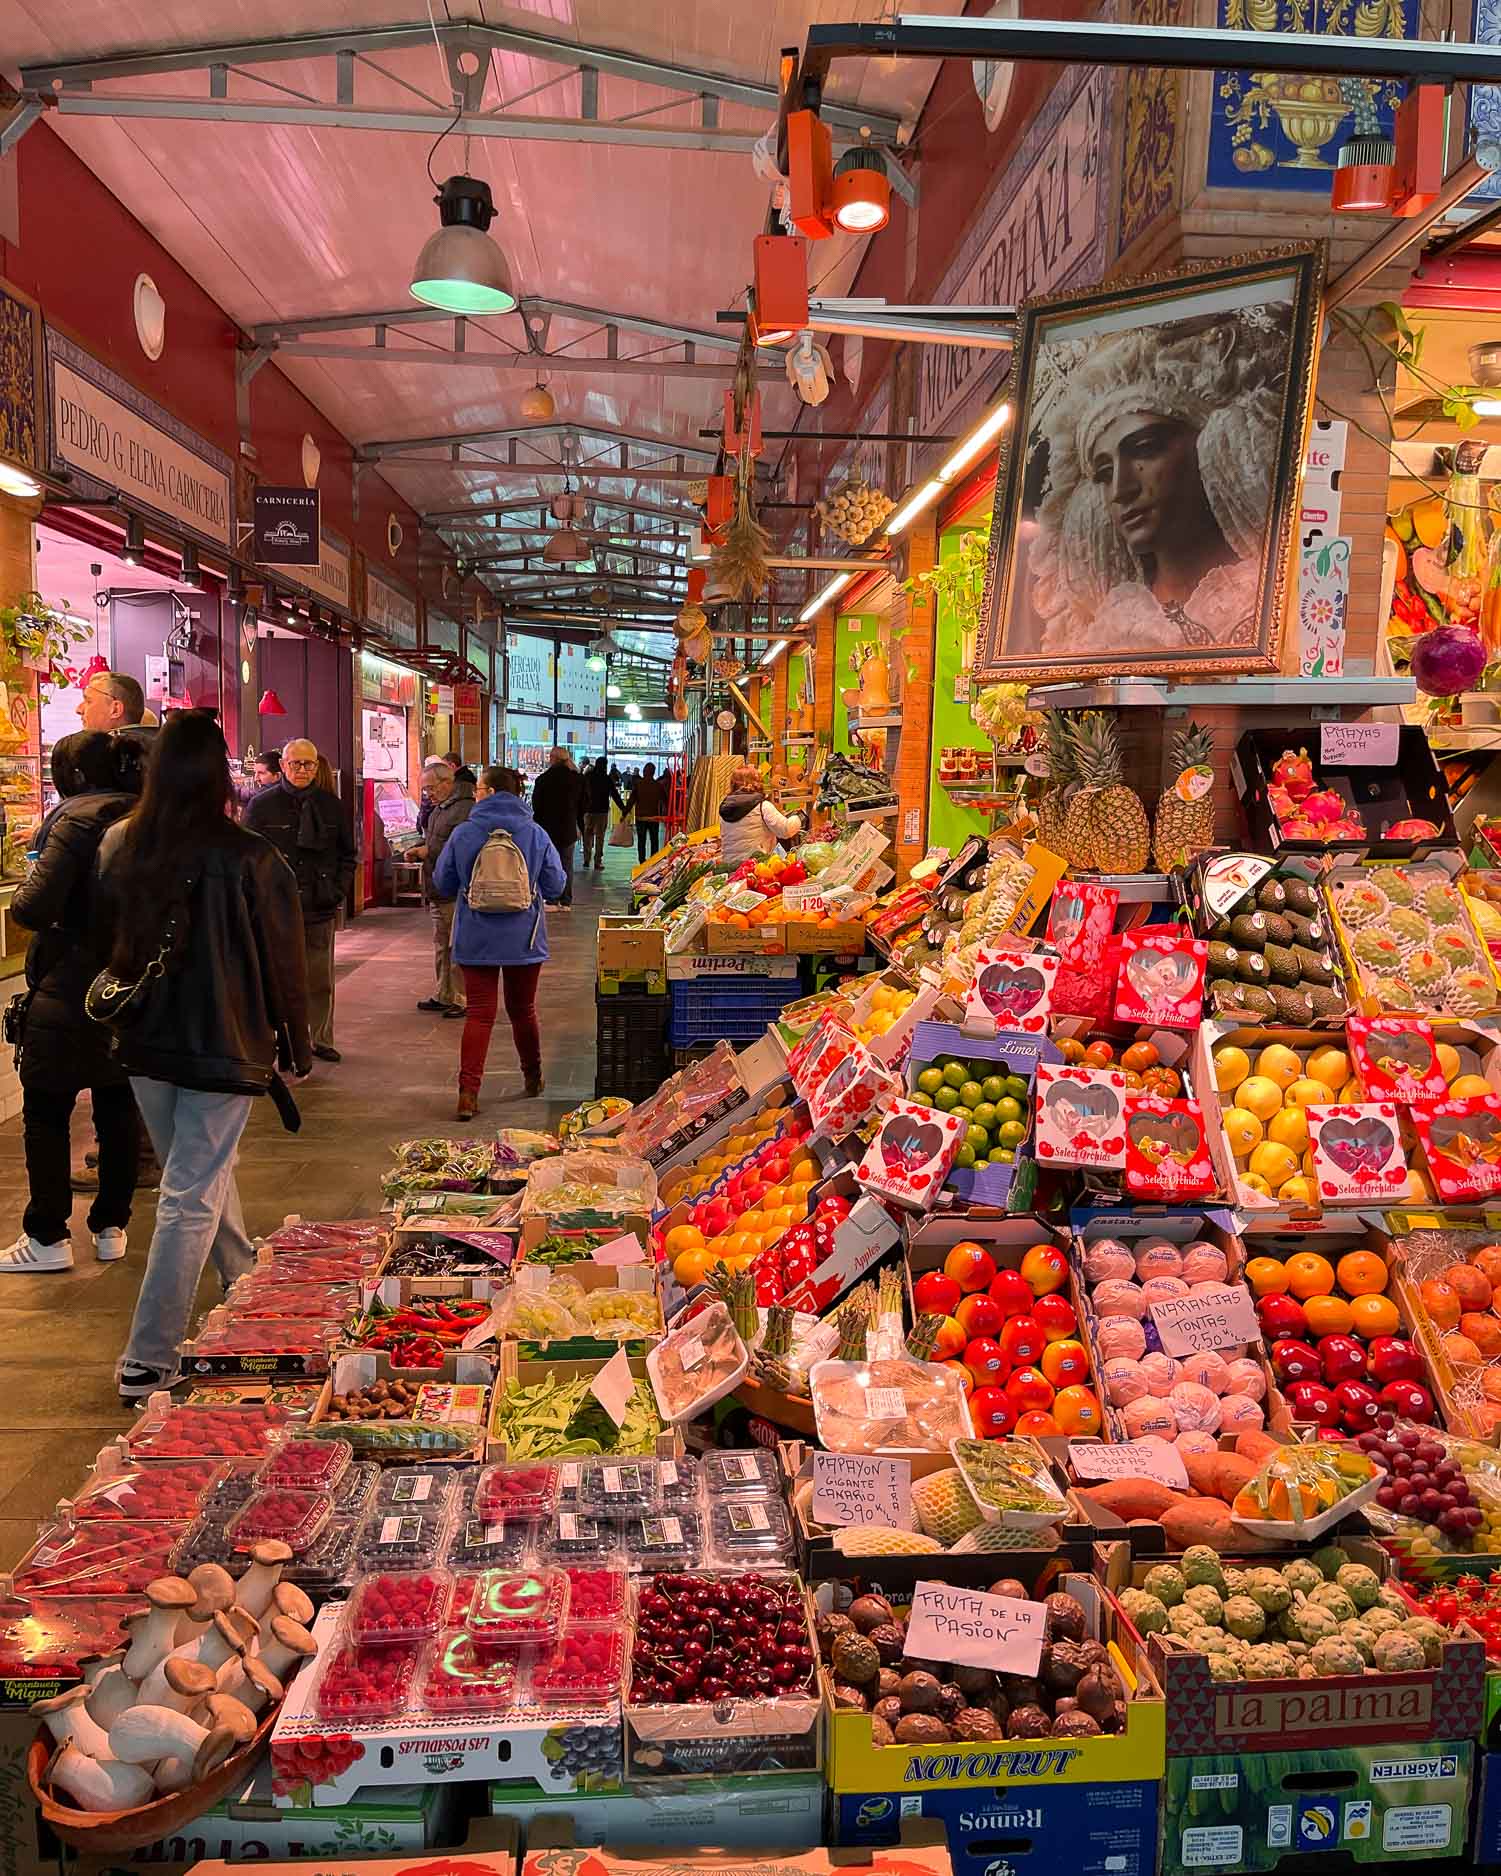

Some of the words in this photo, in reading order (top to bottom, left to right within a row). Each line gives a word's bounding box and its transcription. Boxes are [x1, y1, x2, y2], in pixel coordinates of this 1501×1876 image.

[60, 397, 110, 463] PEDRO
[113, 431, 127, 474] G.
[129, 440, 166, 497] ELENA
[168, 465, 226, 529] CARNICERÍA
[256, 495, 316, 507] CARNICERÍA
[691, 957, 746, 972] Perlim
[1130, 1007, 1155, 1020] Select
[999, 1040, 1038, 1057] Limes
[1054, 1146, 1078, 1159] Select
[1079, 1149, 1111, 1162] Orchids
[868, 1171, 889, 1186] Select
[1144, 1174, 1168, 1186] Select
[1169, 1175, 1200, 1187] Orchids
[1338, 1184, 1362, 1194] Select
[1363, 1183, 1397, 1195] Orchids
[854, 1242, 881, 1271] Apples
[1154, 1291, 1241, 1318] NARANJAS
[1170, 1314, 1227, 1333] TONTAS
[1073, 1445, 1153, 1458] BATATAS
[817, 1456, 884, 1475] PAPAYON
[825, 1476, 874, 1488] GIGANTE
[816, 1487, 876, 1502] CANARIO
[917, 1591, 984, 1617] FRUTA
[991, 1608, 1008, 1619] DE
[1016, 1612, 1031, 1623] LA
[5, 1686, 59, 1700] Miguel
[1223, 1692, 1266, 1728] la
[1278, 1687, 1424, 1733] palma
[399, 1738, 467, 1755] POSADILLAS
[469, 1737, 490, 1750] LAS
[904, 1749, 1077, 1782] NOVOFRUT
[1373, 1762, 1439, 1777] AGRITEN
